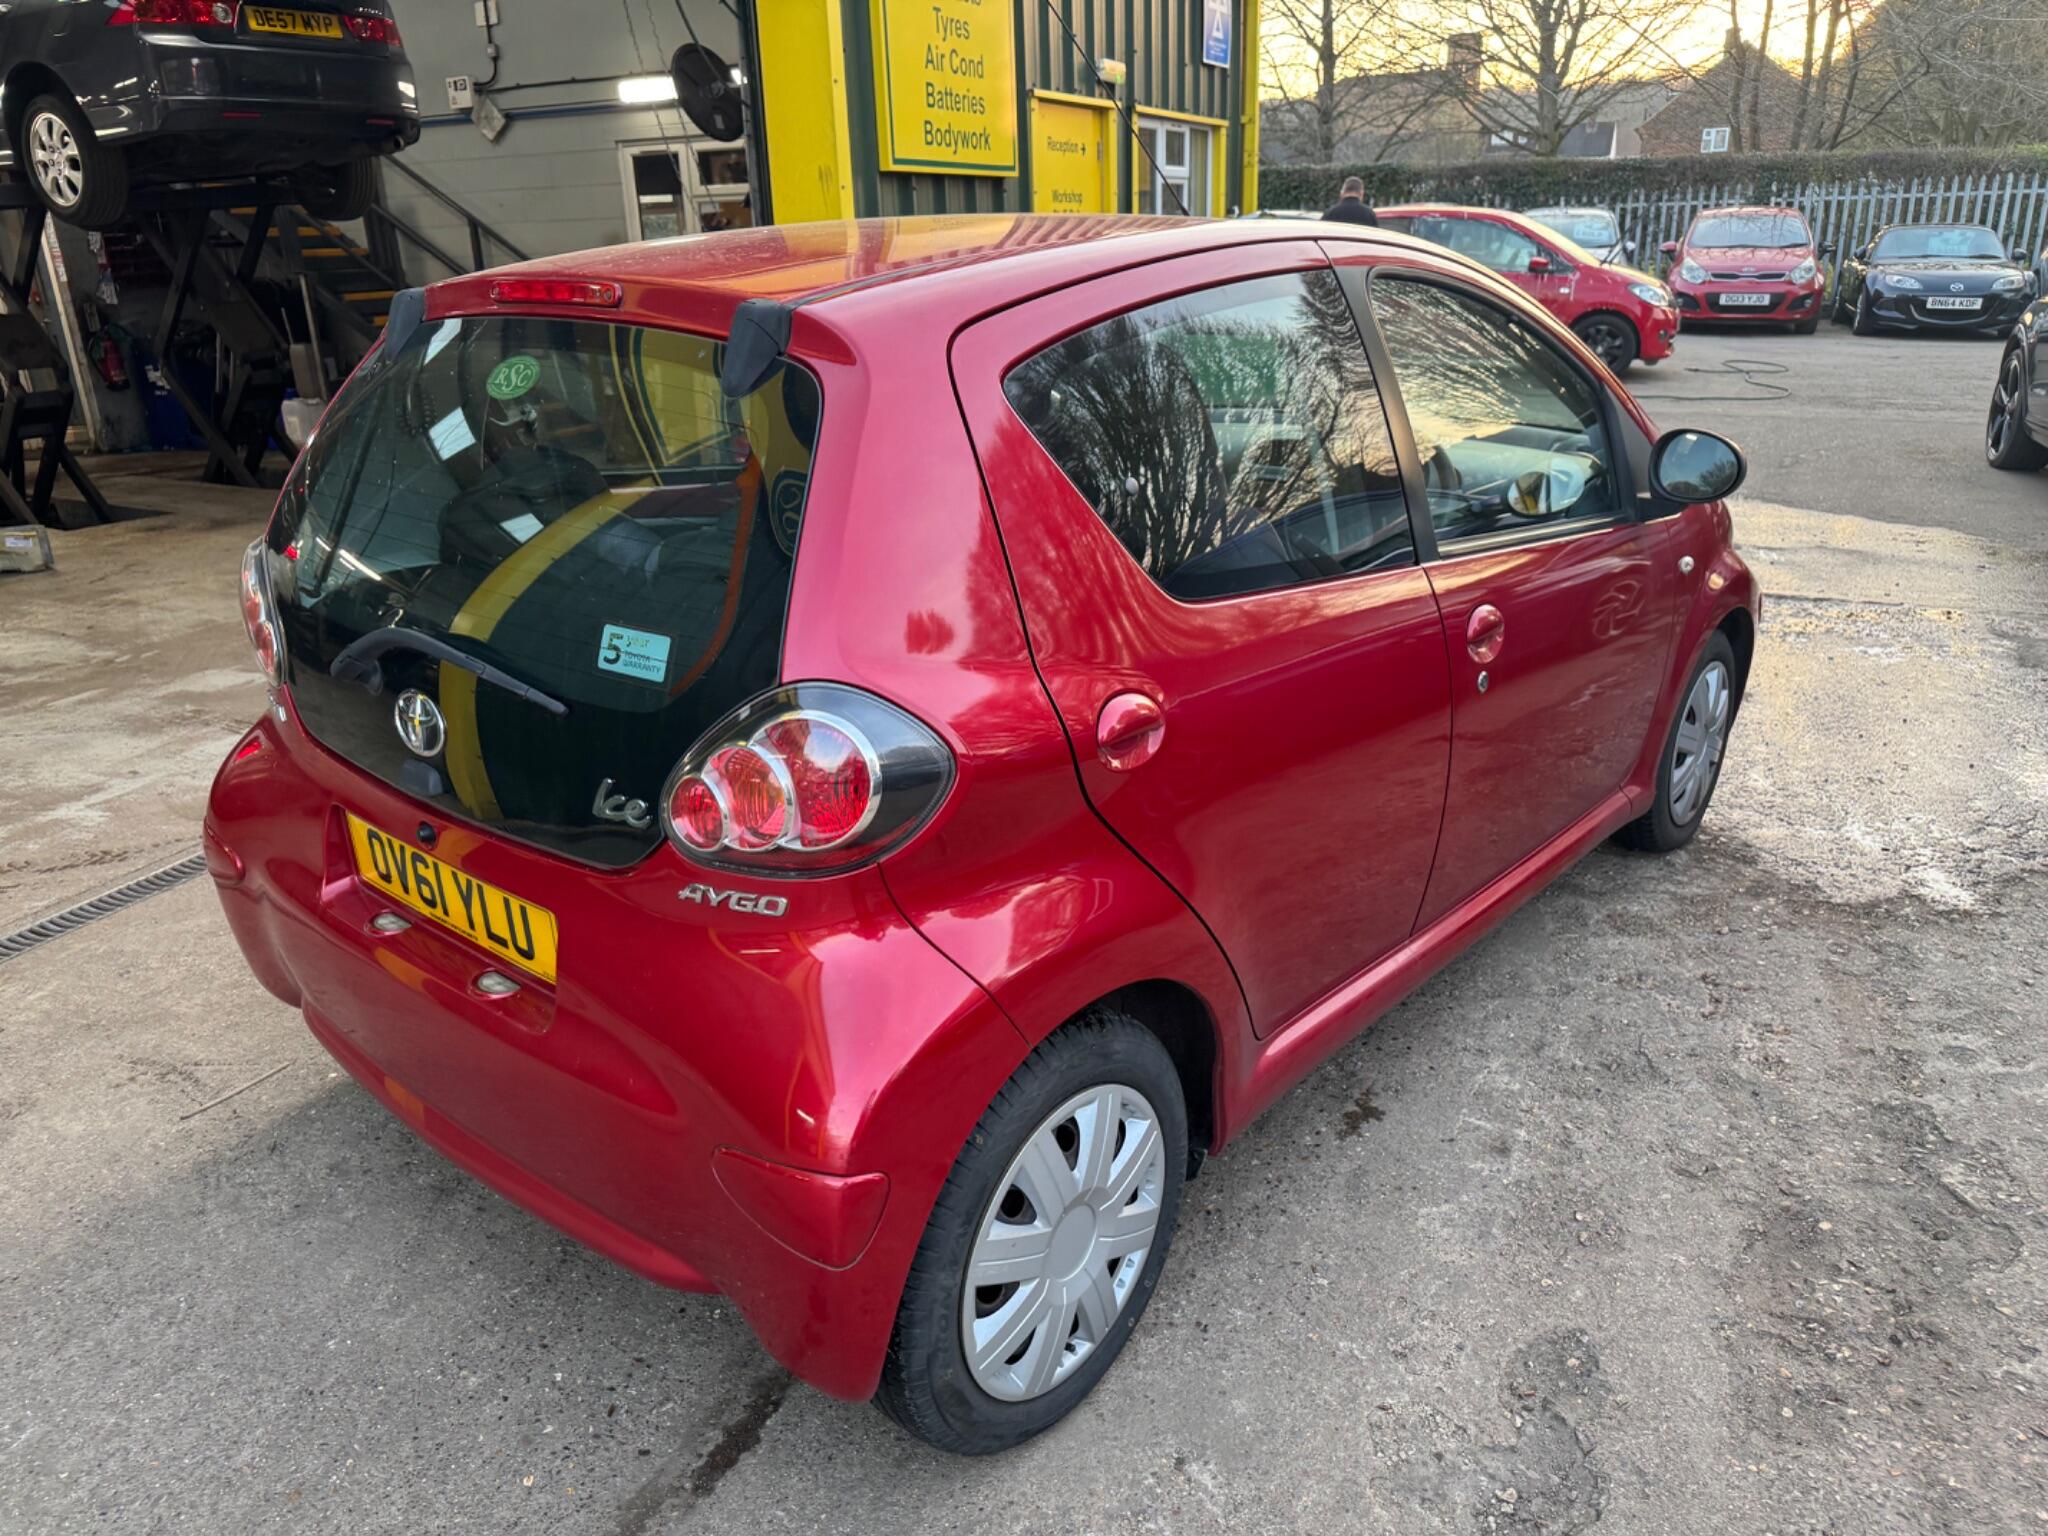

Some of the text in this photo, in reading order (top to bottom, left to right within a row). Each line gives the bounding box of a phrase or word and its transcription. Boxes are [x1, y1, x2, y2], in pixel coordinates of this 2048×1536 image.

[253, 9, 297, 30] DE57
[932, 6, 970, 42] Tyres
[924, 43, 985, 79] Air Cond
[925, 81, 986, 115] Batteries
[923, 119, 992, 155] Bodywork
[1046, 135, 1080, 157] Reception
[1050, 189, 1084, 206] Workshop
[1930, 297, 1956, 307] BN64
[603, 632, 624, 665] 5
[622, 659, 662, 673] WARRANTY
[366, 827, 536, 961] OV61 YLU
[677, 882, 789, 917] AYGO
